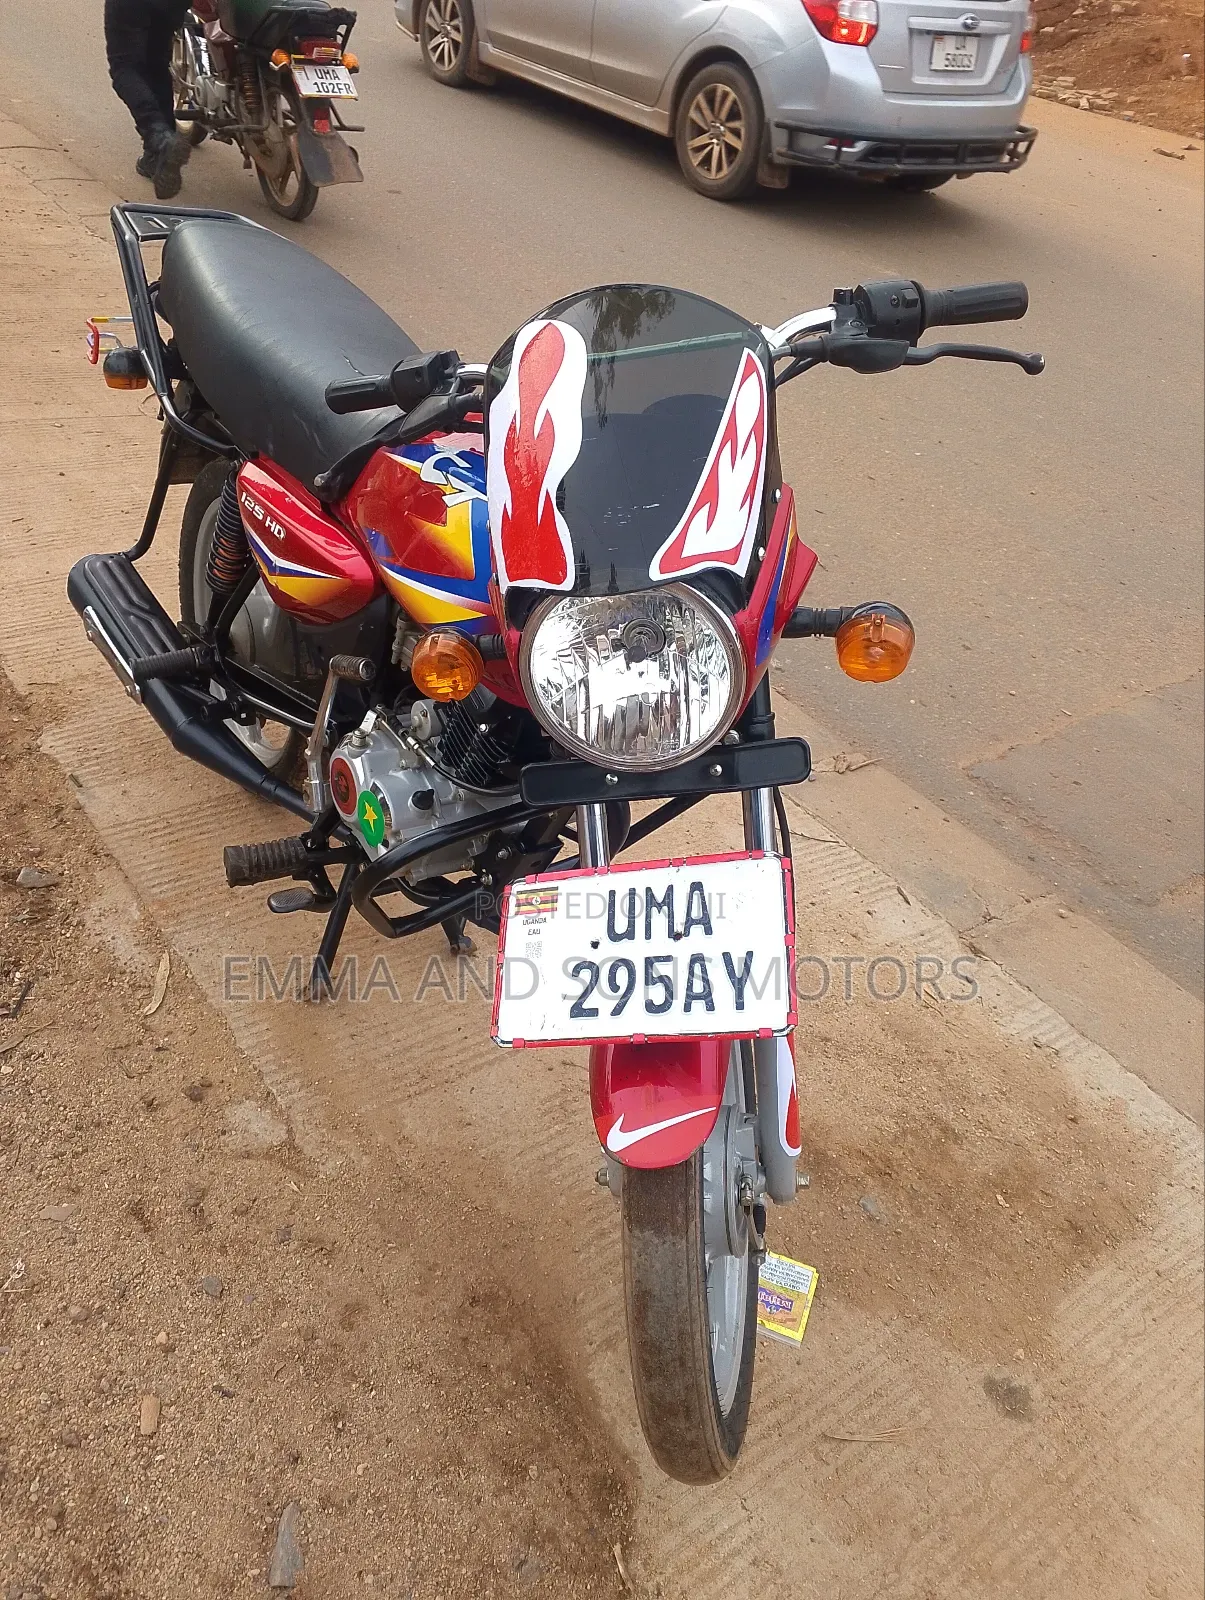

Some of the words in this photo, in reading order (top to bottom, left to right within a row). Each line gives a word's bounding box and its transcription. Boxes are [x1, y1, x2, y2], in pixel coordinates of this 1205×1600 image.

[313, 81, 353, 94] 102FR
[314, 68, 341, 80] UMA
[241, 491, 265, 520] 125
[264, 515, 286, 540] HD
[522, 917, 547, 926] UGANDA
[606, 881, 713, 942] UMA
[569, 950, 754, 1019] 295AY
